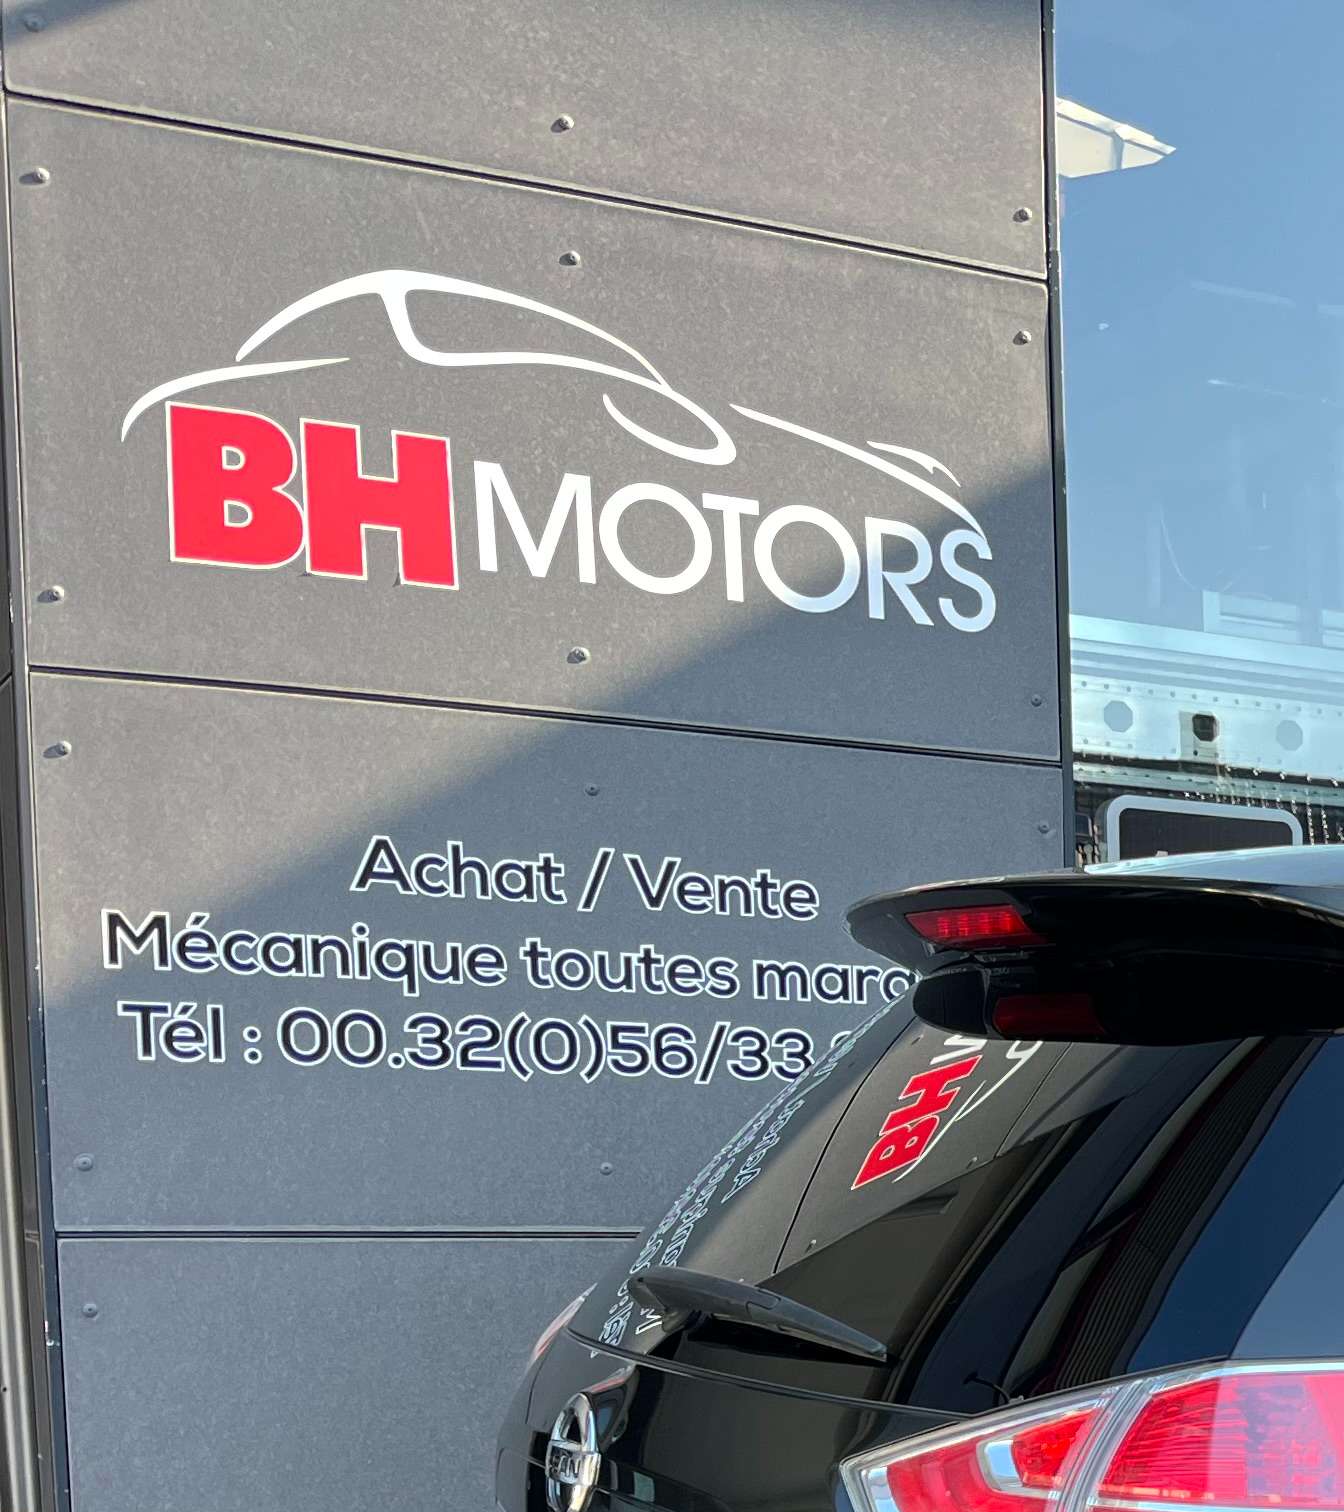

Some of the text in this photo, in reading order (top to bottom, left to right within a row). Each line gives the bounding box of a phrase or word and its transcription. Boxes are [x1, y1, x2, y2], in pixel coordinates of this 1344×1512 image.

[166, 400, 998, 634] BH MOTORS
[349, 835, 820, 920] Achat / Vente
[101, 908, 508, 997] Mécanique
[520, 937, 740, 999] toutes
[118, 1001, 226, 1063] Tél
[277, 1006, 815, 1085] 00.32(0)56/33
